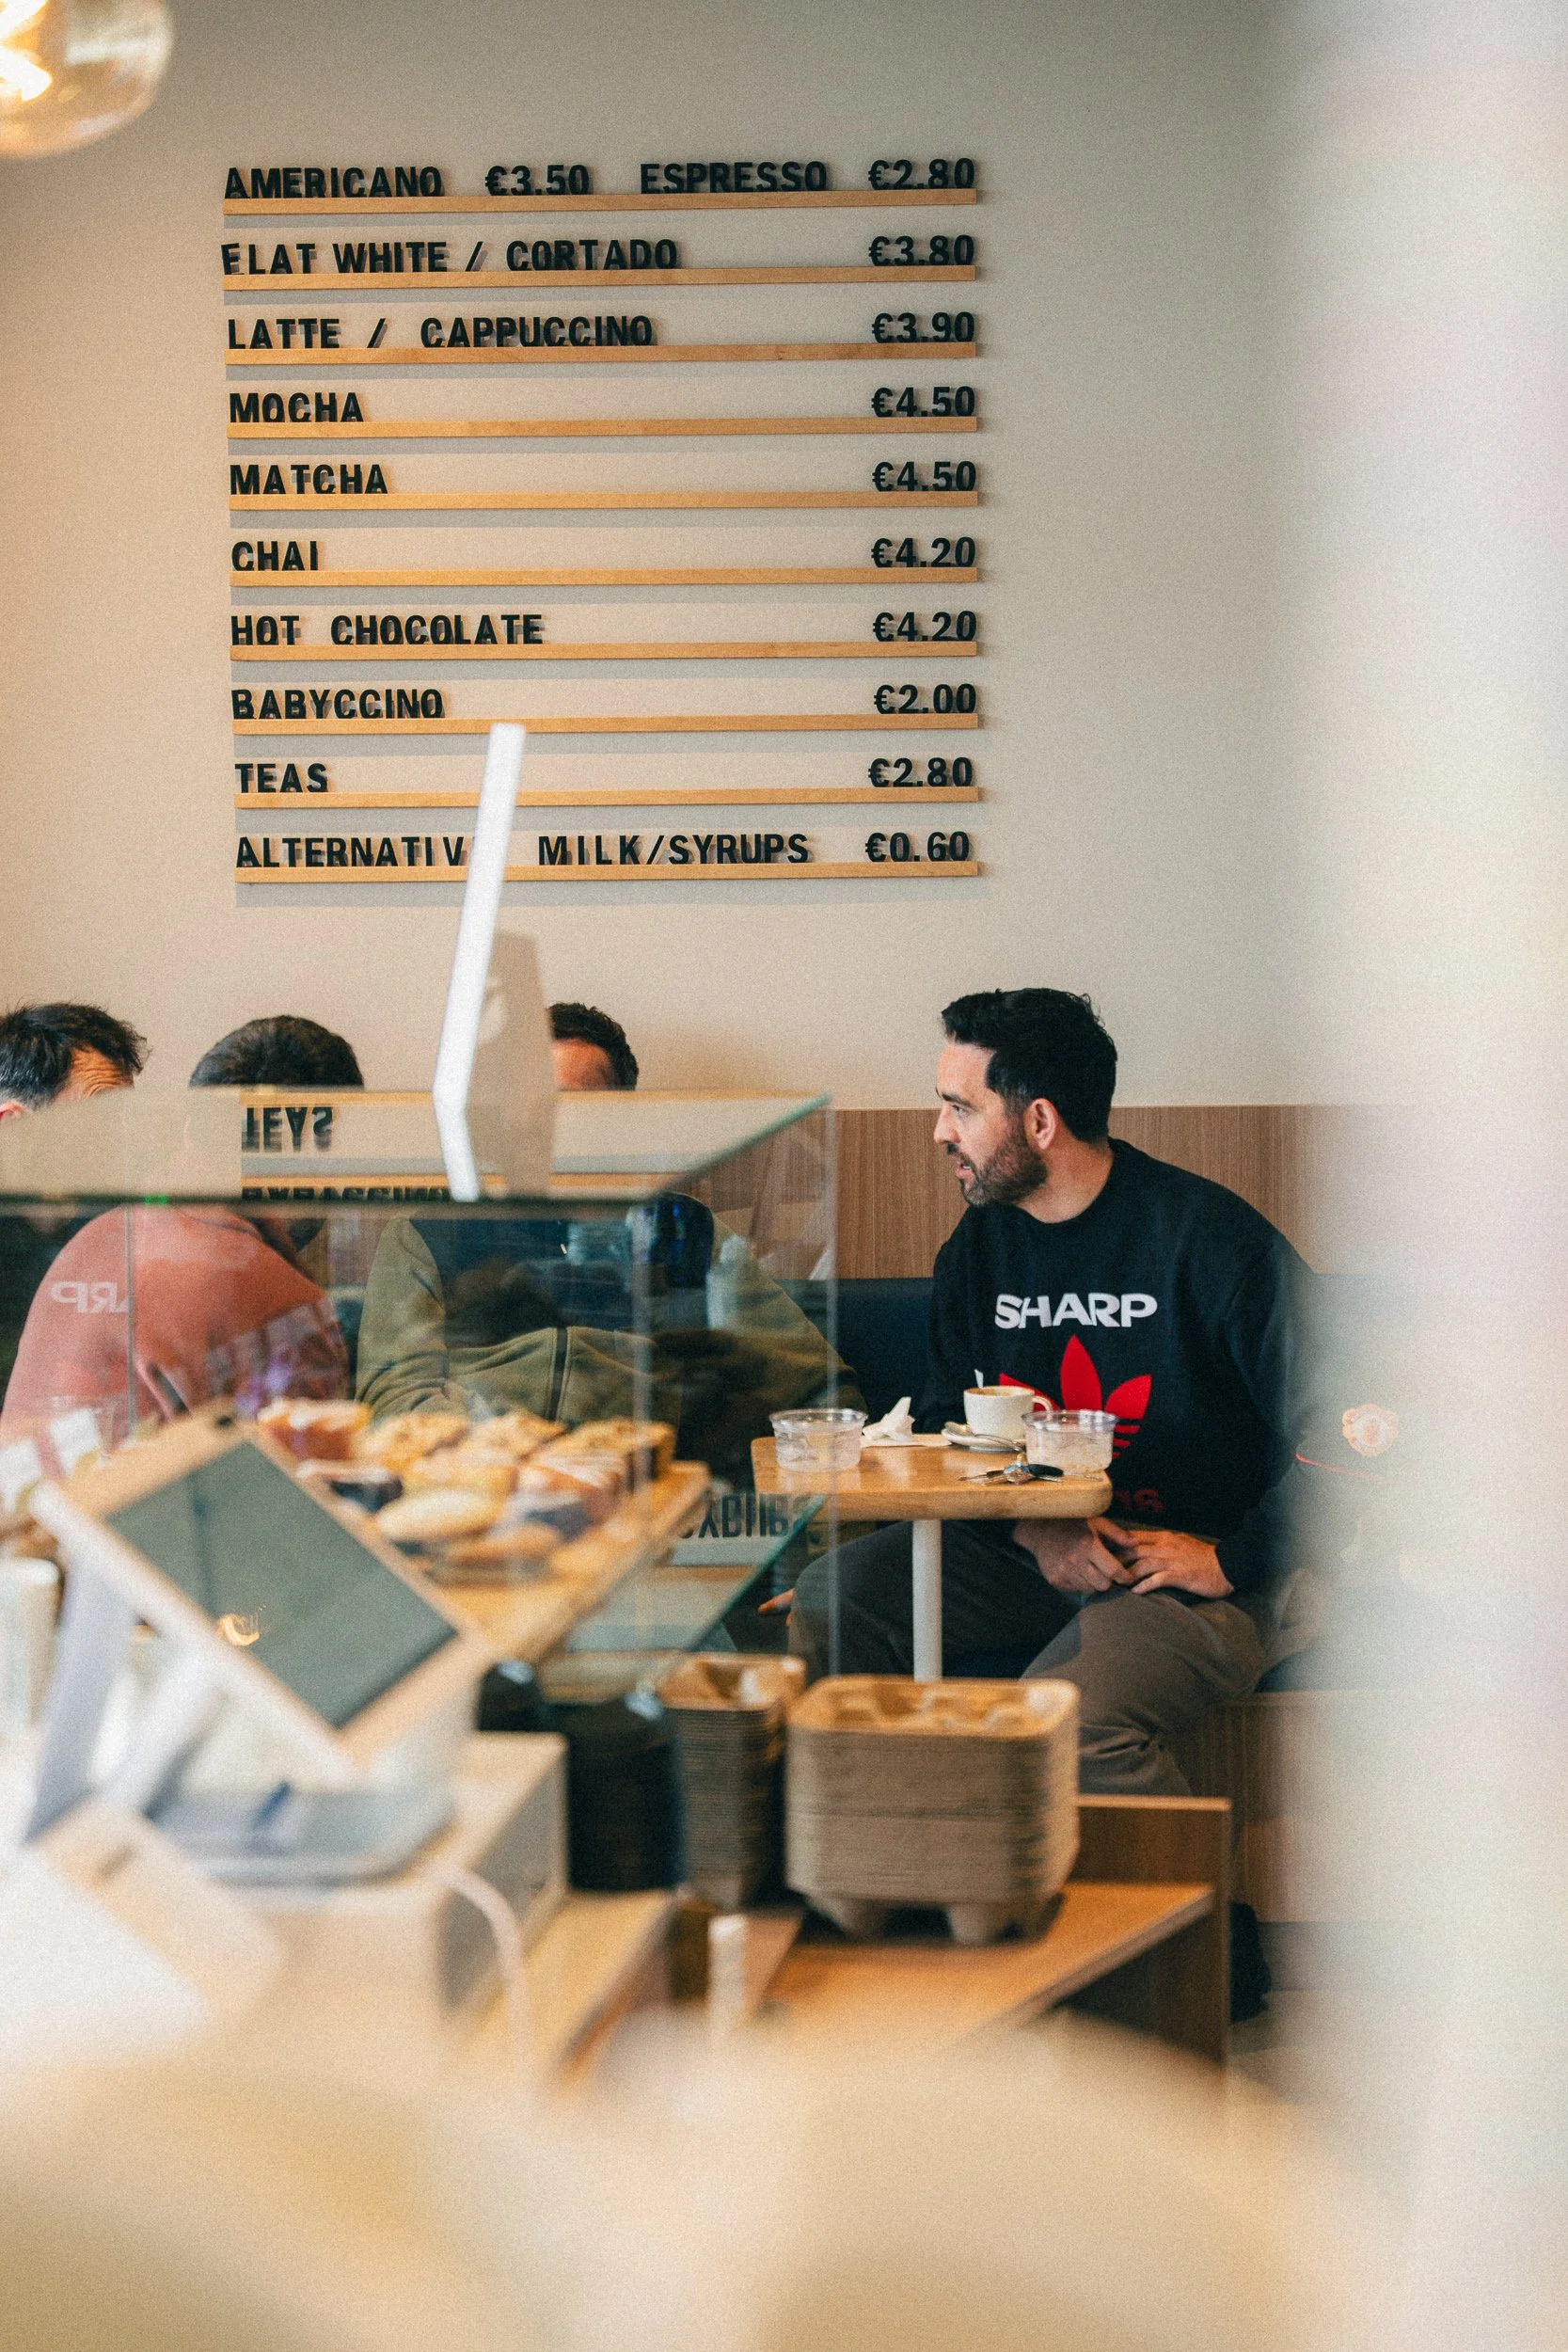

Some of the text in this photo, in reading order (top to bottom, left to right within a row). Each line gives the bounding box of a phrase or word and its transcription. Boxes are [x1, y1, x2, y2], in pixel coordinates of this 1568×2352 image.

[225, 158, 976, 199] AMERICANO €3.50 ESPRESSO €2.80
[222, 235, 974, 274] FLAT WHITE / CORTADO €3.80
[230, 312, 974, 348] LATTE / CAPPUCCINO €3.90
[230, 387, 975, 421] MOCHA €4.50
[231, 461, 976, 494] MATCHA €4.50
[232, 537, 975, 570] CHAI €4.20
[232, 612, 976, 644] HOT CHOCOLATE €4.20
[232, 684, 976, 719] BABYCCINO €2.00
[236, 757, 973, 792] TEAS €2.80
[235, 832, 969, 867] ALTERNATIV MILK/SYRUPS €0.60
[994, 1293, 1158, 1329] SHARP
